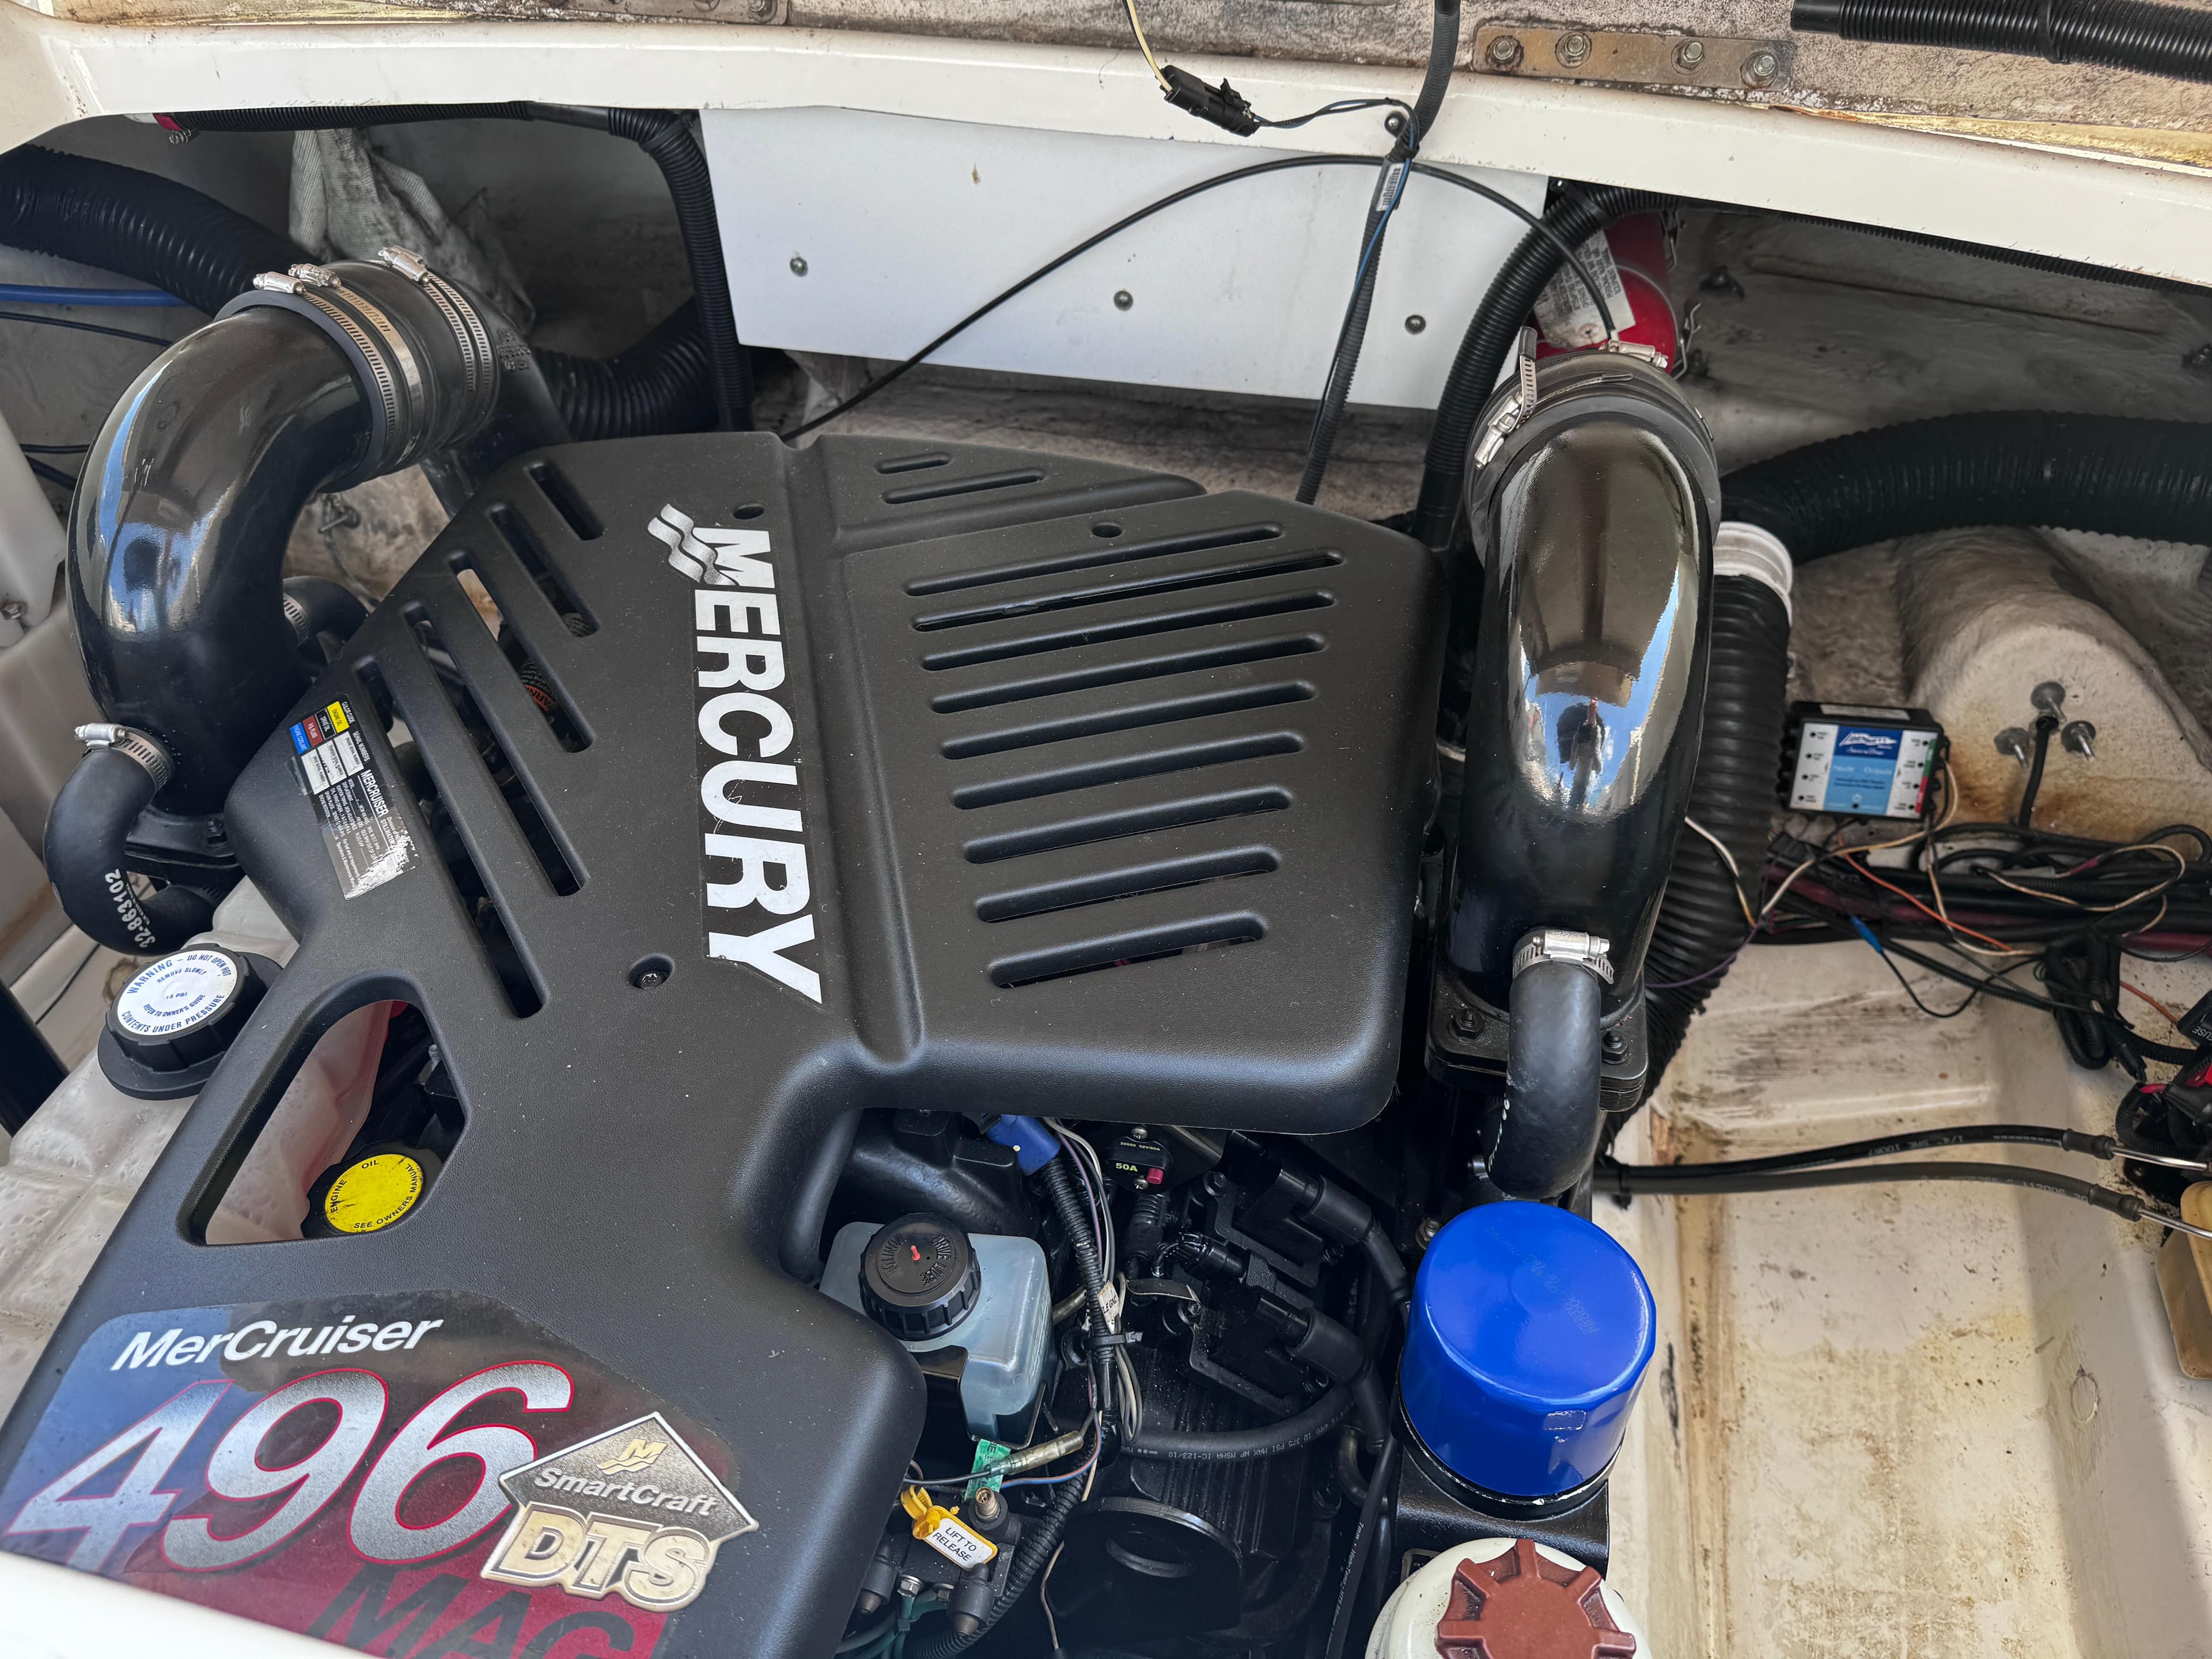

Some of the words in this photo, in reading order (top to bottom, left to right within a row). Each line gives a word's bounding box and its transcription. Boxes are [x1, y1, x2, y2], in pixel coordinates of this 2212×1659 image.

[346, 712, 355, 724] CODE
[296, 734, 308, 752] COOLANT
[308, 727, 319, 739] FLUID
[353, 731, 362, 744] SERIAL
[358, 743, 370, 761] NUMBERS
[692, 527, 822, 1004] MERCURY
[362, 770, 388, 817] MERCRUISER
[105, 869, 156, 947] 32-863102
[127, 959, 173, 994] WARNING
[211, 956, 225, 969] OPEN
[222, 966, 231, 976] HOT
[157, 968, 182, 983] REMOVE
[185, 967, 207, 976] SLOWLY
[121, 1011, 150, 1033] CONTENTS
[153, 1021, 182, 1033] UNDER
[185, 994, 226, 1024] PRESSURE
[163, 1005, 190, 1017] OWNER'S
[190, 994, 206, 1007] GUIDE
[1116, 1162, 1137, 1172] 50A
[331, 1180, 347, 1213] ENGINE
[362, 1160, 379, 1169] OIL
[377, 1196, 412, 1224] OWNERS
[406, 1164, 418, 1193] MANUAL
[881, 1232, 907, 1277] MONITOR
[931, 1234, 952, 1260] DRIVE
[920, 1262, 948, 1286] LUBE
[111, 1316, 445, 1371] MerCruiser
[1167, 1449, 1211, 1461] IC-123/10
[1215, 1451, 1236, 1459] MSHA
[1240, 1449, 1249, 1457] WP
[1253, 1447, 1267, 1456] MAX
[1271, 1442, 1285, 1452] PSI
[1287, 1437, 1301, 1448] 375
[2, 1362, 575, 1573] 496
[533, 1467, 719, 1517] SmartCraft
[945, 1527, 966, 1543] LIFT
[964, 1539, 978, 1552] TO
[1354, 1521, 1365, 1541] 7mm
[495, 1504, 712, 1606] DTS
[933, 1532, 972, 1562] RELEASE
